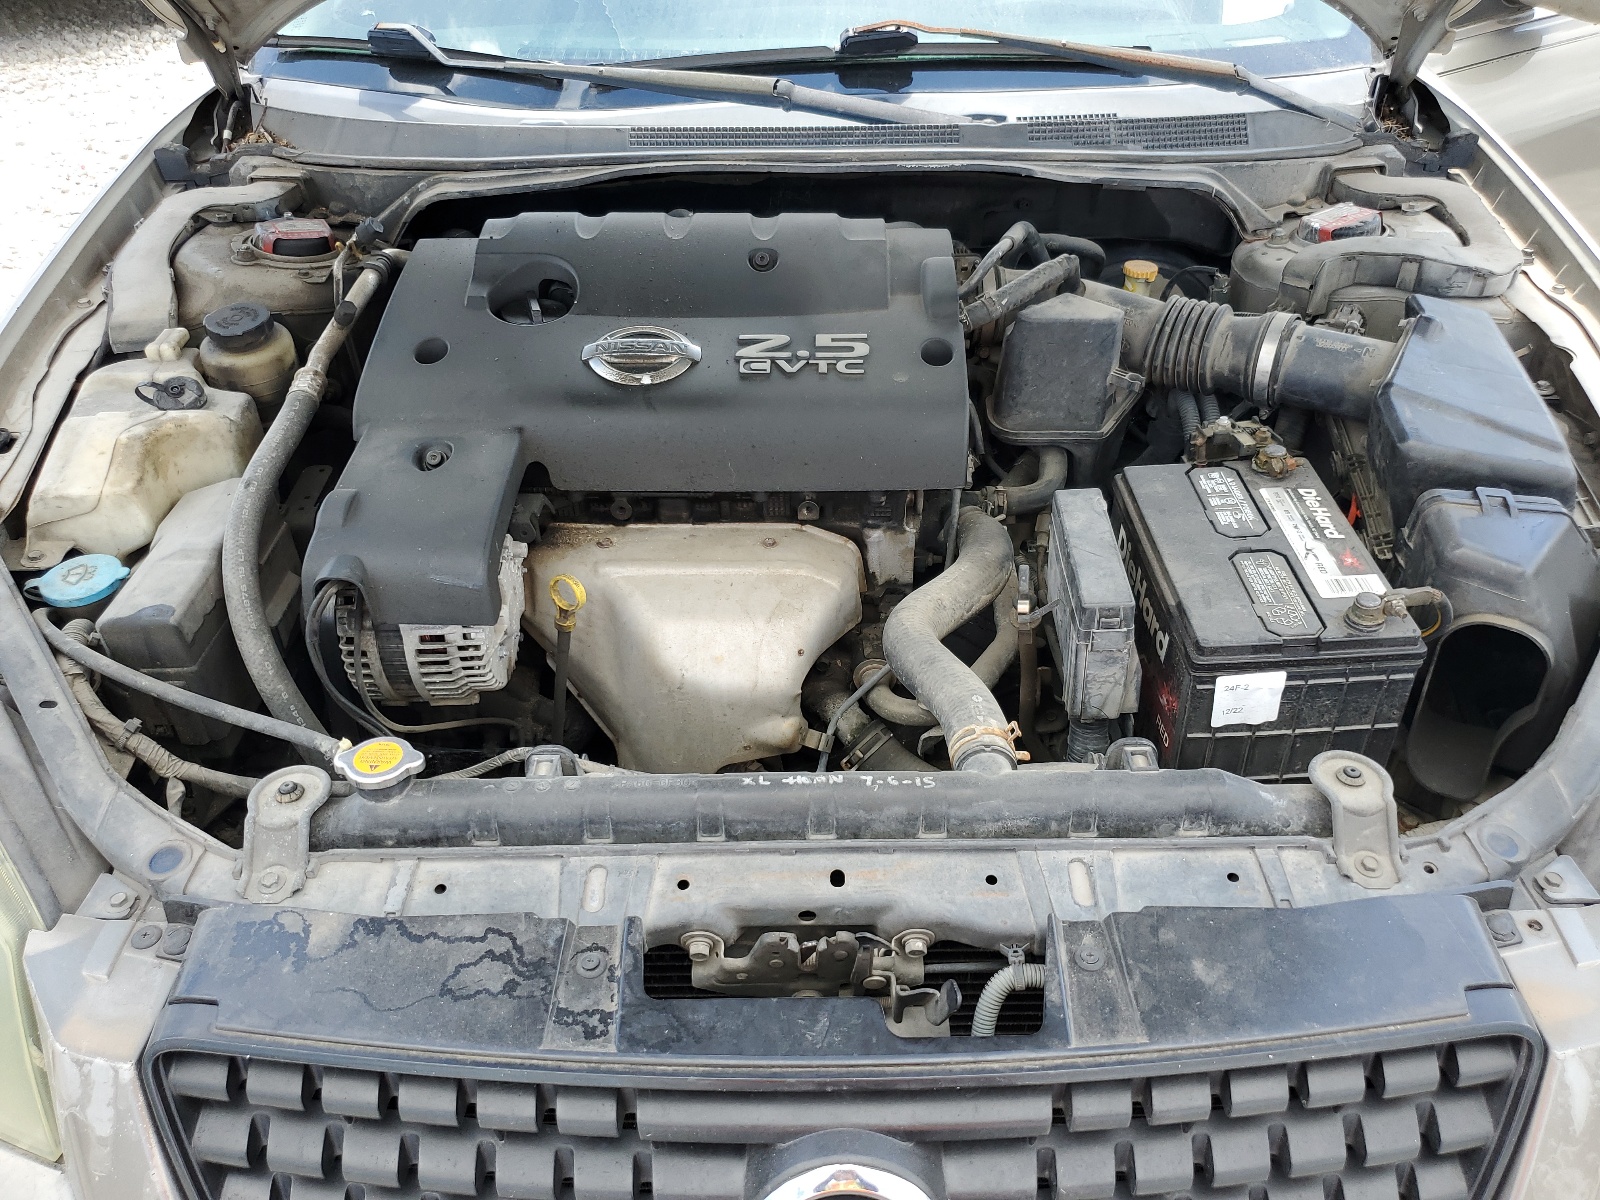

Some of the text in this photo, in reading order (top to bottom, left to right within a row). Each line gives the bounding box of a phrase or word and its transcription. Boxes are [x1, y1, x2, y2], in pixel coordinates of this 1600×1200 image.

[594, 339, 688, 354] NISSAN
[735, 333, 870, 358] 2.5
[1297, 488, 1346, 539] DieHard
[1117, 523, 1170, 665] DieHard
[1224, 684, 1250, 692] 24F-2
[1222, 707, 1244, 716] 12/22
[1155, 713, 1170, 748] RED
[741, 775, 772, 786] XL
